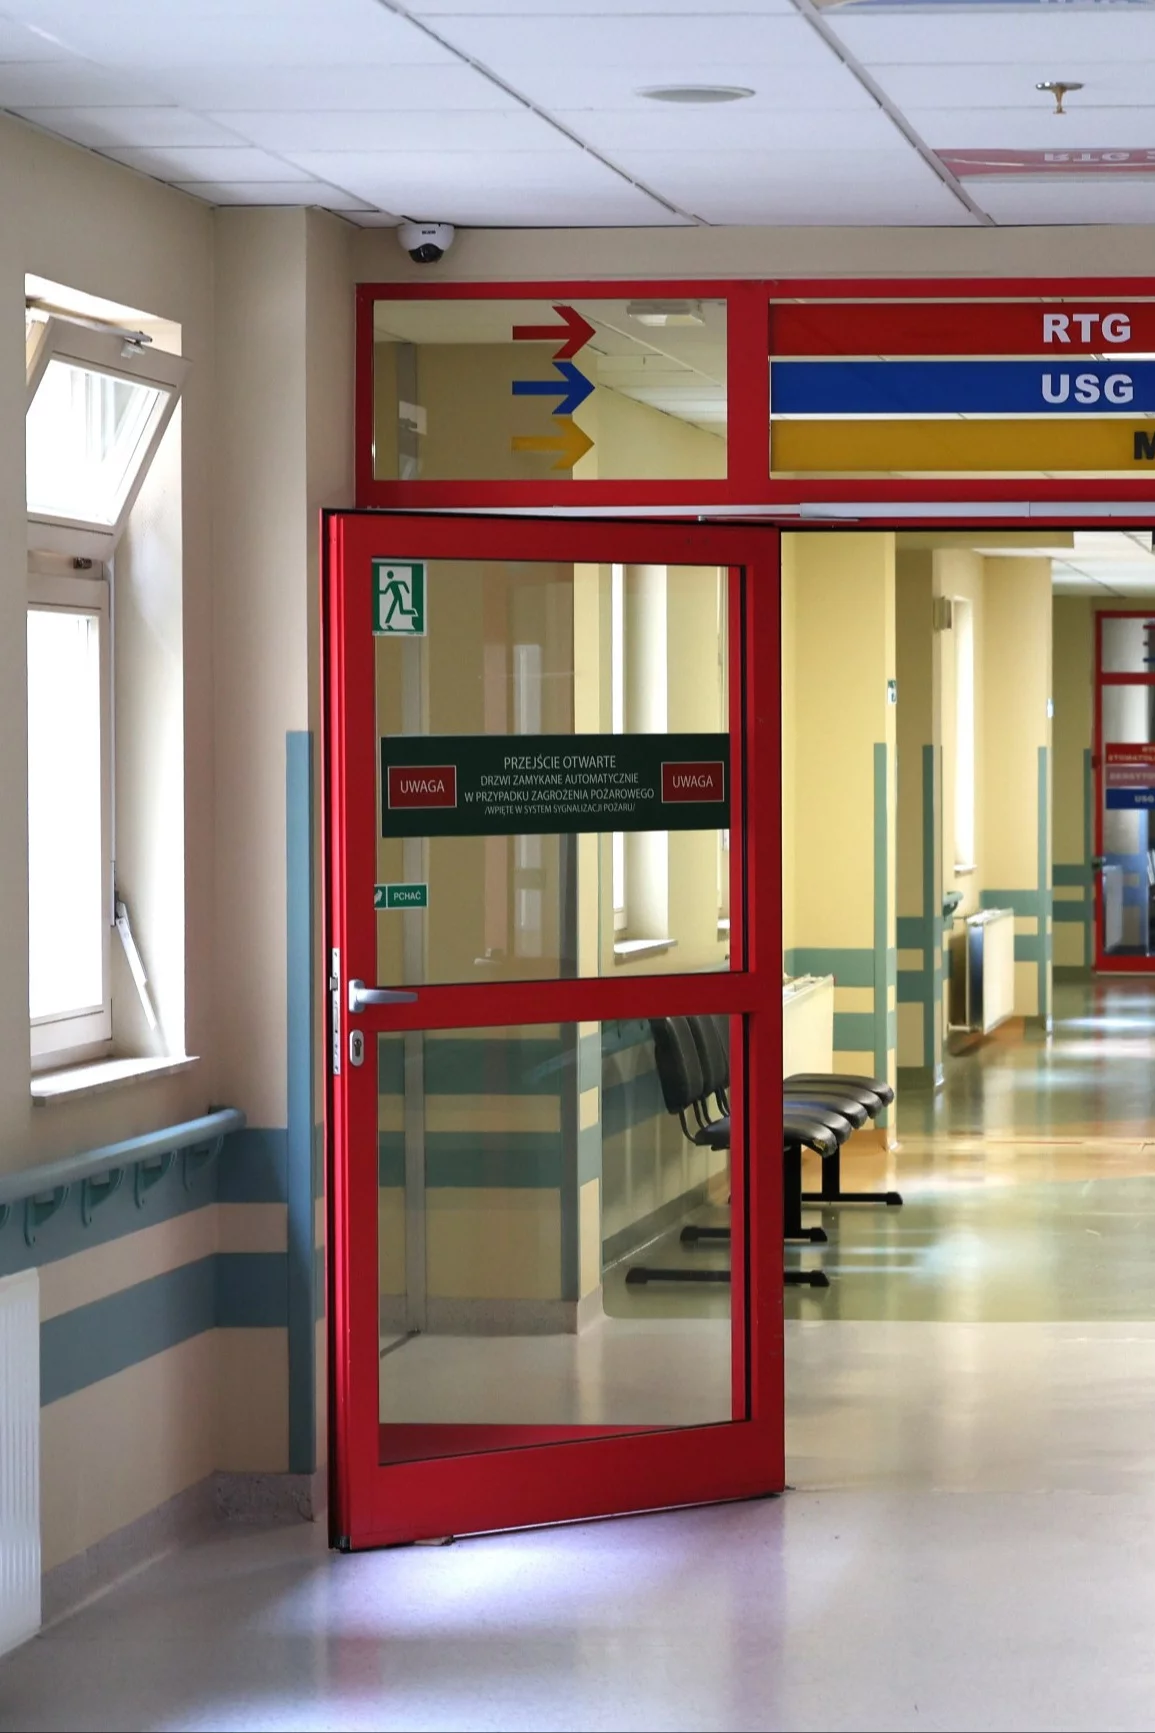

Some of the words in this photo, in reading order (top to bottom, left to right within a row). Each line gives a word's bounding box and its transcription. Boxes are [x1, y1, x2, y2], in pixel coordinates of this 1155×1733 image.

[1042, 313, 1132, 343] RTG
[1041, 373, 1135, 404] USG
[504, 754, 560, 770] PRZEJŚCIE
[562, 755, 617, 769] OTWARTE
[480, 774, 511, 786] DRZWI
[512, 773, 564, 786] ZAMYKANE
[565, 772, 639, 785] AUTOMATYCZNIE
[672, 774, 714, 788] UWAGA
[399, 780, 445, 794] UWAGA
[464, 791, 474, 802] W
[475, 790, 529, 802] PRZYPADKU
[531, 788, 589, 801] ZAGROŻENIA
[590, 787, 655, 800] POŻAROWEGO
[515, 805, 523, 814] W
[524, 804, 552, 814] SYSTEM
[553, 803, 602, 813] SYGNALIZACJI
[393, 890, 421, 901] PCHAĆ
